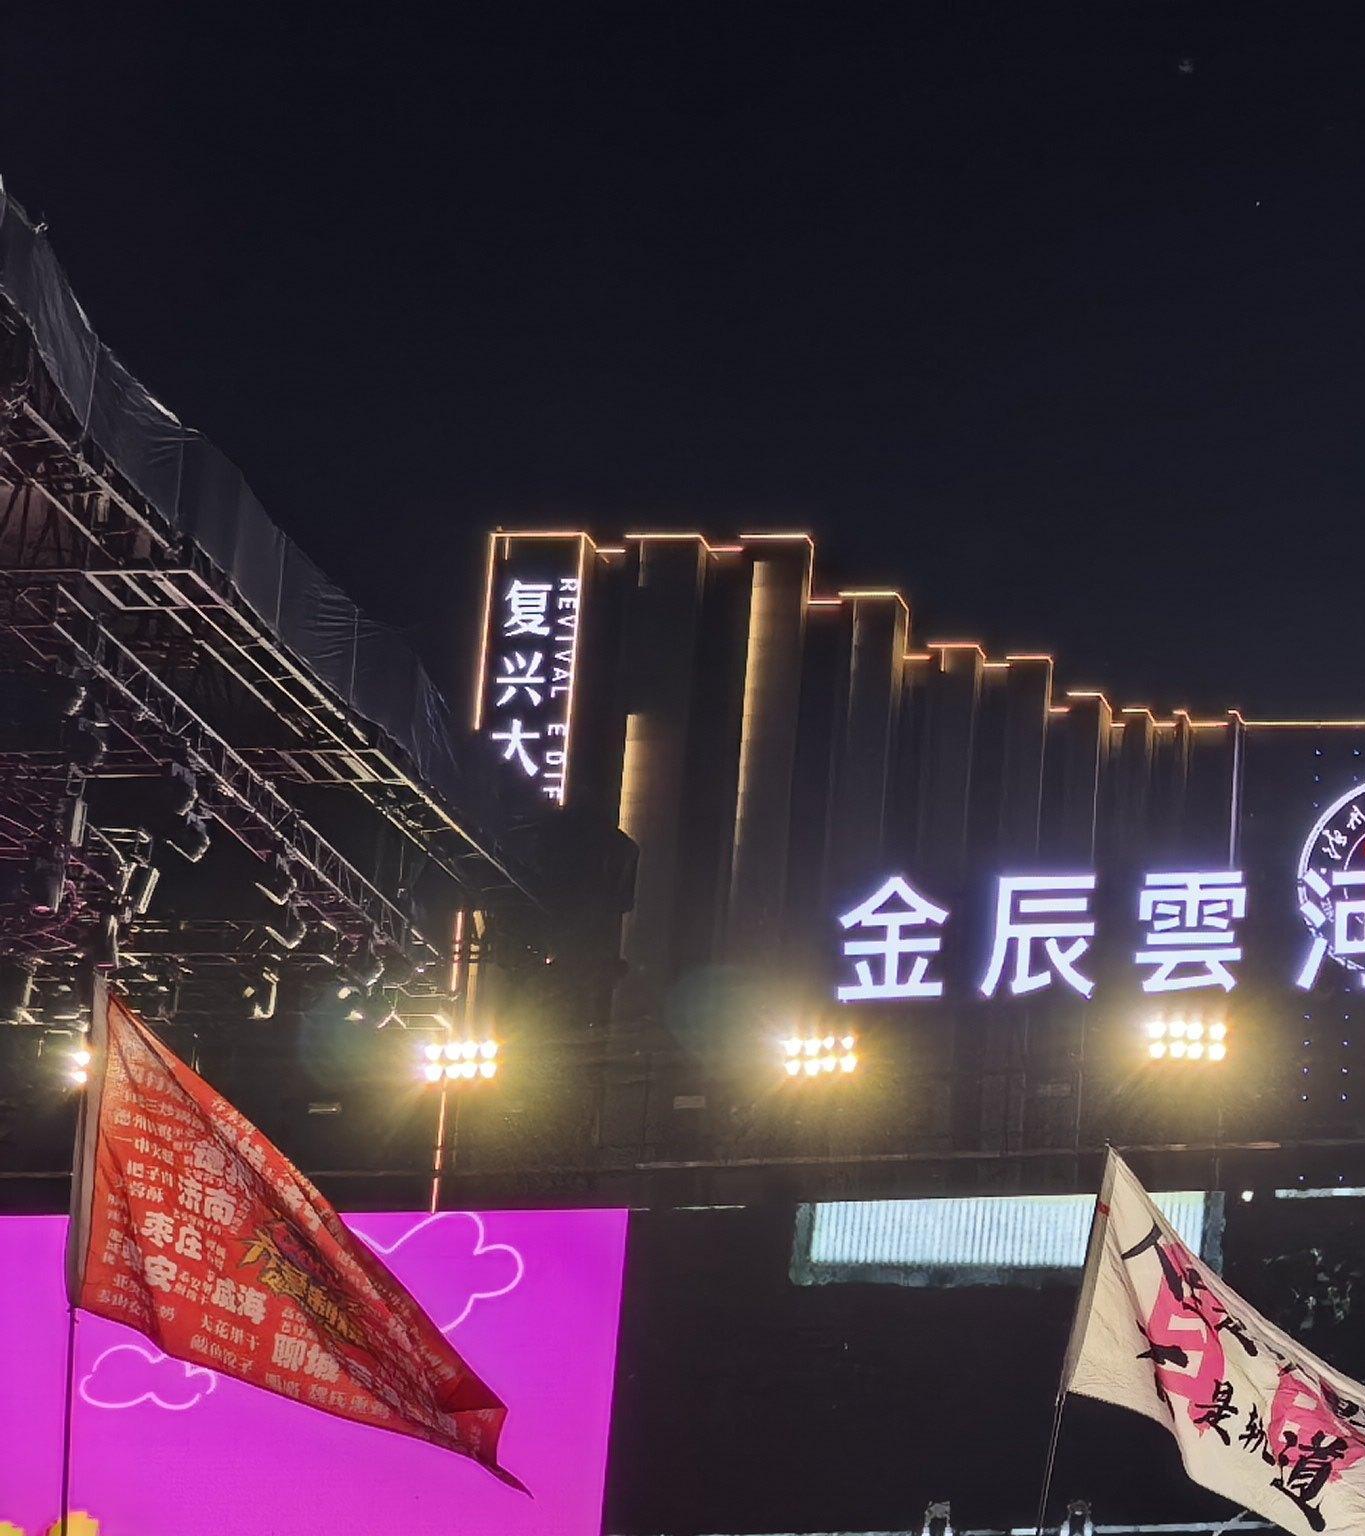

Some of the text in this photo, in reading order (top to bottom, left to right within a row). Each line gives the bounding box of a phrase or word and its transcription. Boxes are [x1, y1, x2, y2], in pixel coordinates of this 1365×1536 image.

[549, 577, 579, 700] REVIVAL
[140, 1210, 203, 1261] 枣庄
[271, 1332, 342, 1384] 聊城
